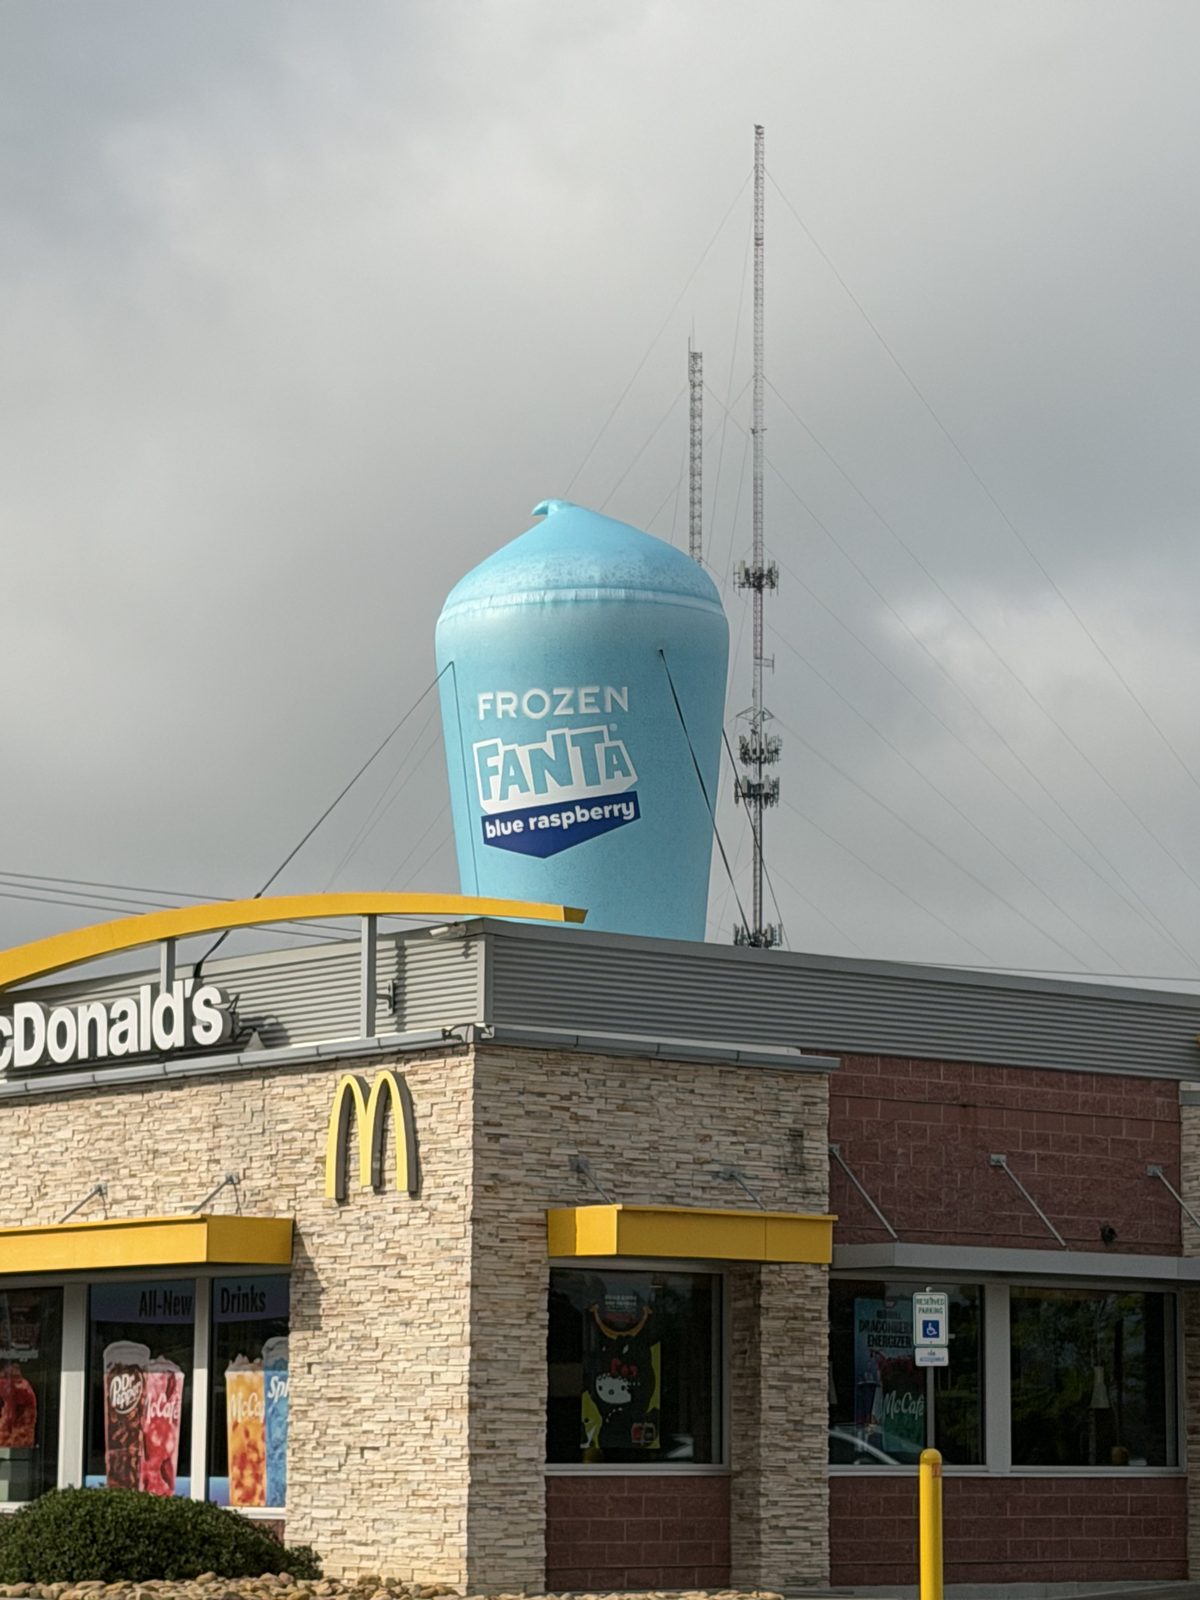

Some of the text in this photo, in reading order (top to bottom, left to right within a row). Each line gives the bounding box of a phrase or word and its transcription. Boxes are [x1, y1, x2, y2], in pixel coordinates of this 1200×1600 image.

[477, 686, 629, 721] FROZEN
[475, 728, 634, 804] FANTA
[485, 800, 635, 839] blue raspberry
[139, 1285, 267, 1318] All-New Drinks
[918, 1306, 944, 1314] PARKING
[121, 1373, 136, 1391] Dr
